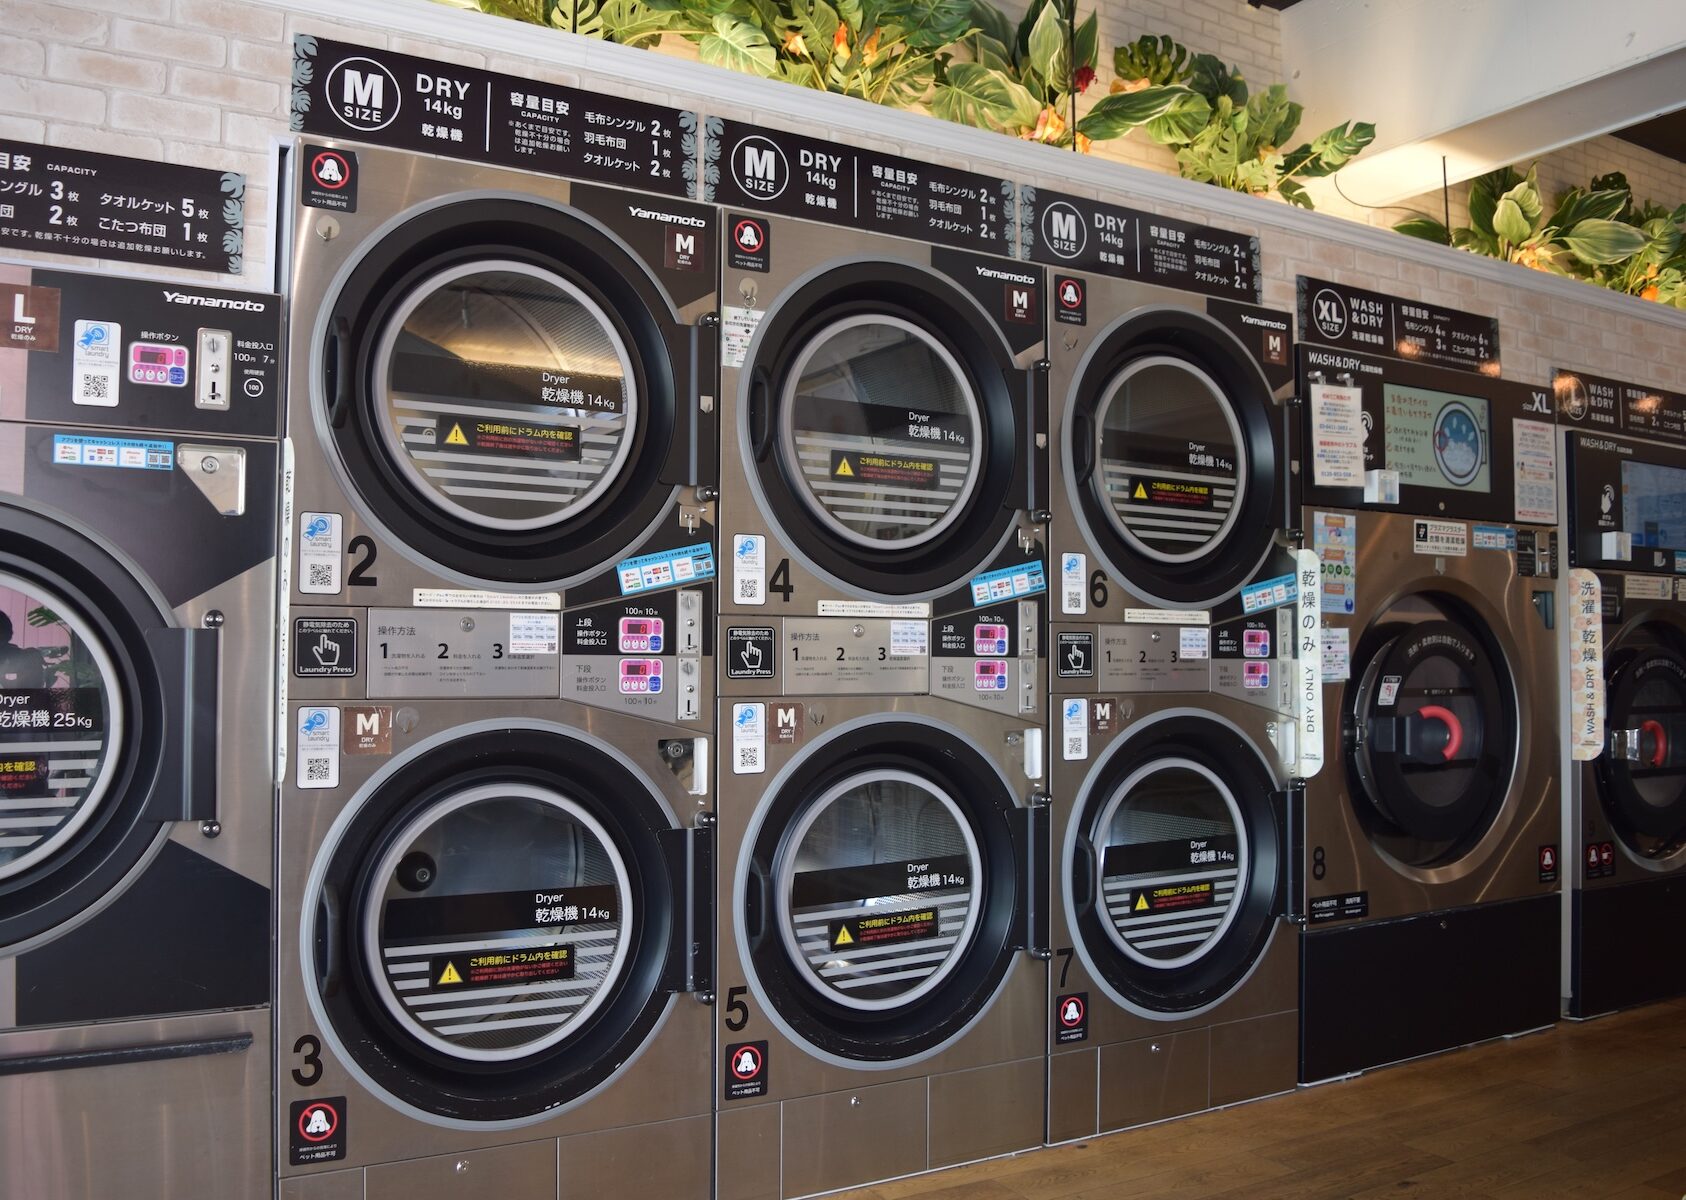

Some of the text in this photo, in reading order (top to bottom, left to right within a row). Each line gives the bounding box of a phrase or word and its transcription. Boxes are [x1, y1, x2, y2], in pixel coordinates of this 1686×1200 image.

[343, 69, 383, 109] M
[416, 73, 470, 100] DRY
[424, 98, 463, 120] 14kg
[510, 92, 570, 116] 容量目安
[344, 106, 381, 122] SIZE
[521, 111, 560, 123] CAPACITY
[584, 111, 646, 133] 毛布シングル
[421, 123, 463, 142] 乾燥機
[584, 131, 627, 150] 羽毛布団
[47, 163, 97, 176] CAPACITY
[583, 153, 640, 172] タオルケット
[744, 146, 775, 181] M
[800, 149, 841, 173] DRY
[807, 171, 836, 190] 14kg
[872, 165, 918, 186] 容量目安
[745, 179, 775, 193] SIZE
[881, 182, 911, 192] CAPACITY
[929, 182, 976, 200] 毛布シングル
[100, 193, 175, 214] タオルケット
[805, 192, 837, 210] 乾燥機
[929, 200, 962, 215] 羽毛布団
[629, 206, 705, 228] Yamamoto
[929, 217, 973, 234] タオルケット
[1052, 211, 1076, 241] M
[1094, 213, 1127, 233] DRY
[99, 217, 166, 238] こたつ布団
[1150, 226, 1185, 243] 容量目安
[676, 232, 695, 255] M
[1054, 240, 1076, 252] SIZE
[1100, 232, 1123, 248] 14kg
[976, 266, 1035, 284] Yamamoto
[1195, 271, 1229, 285] タオルケット
[14, 293, 36, 323] L
[163, 291, 265, 312] Yamamoto
[1013, 290, 1028, 309] M
[1350, 297, 1384, 315] WASH
[1318, 299, 1343, 324] XL
[1352, 312, 1384, 328] &DRY
[1241, 314, 1286, 330] Yamamoto
[1322, 322, 1340, 333] SIZE
[141, 330, 179, 342] 操作ボタン
[1269, 335, 1280, 352] M
[237, 340, 273, 351] 料金投入口
[1308, 351, 1361, 371] WASH&DRY
[542, 373, 570, 384] Dryer
[542, 387, 615, 410] 乾燥機 14Kg
[1589, 384, 1613, 397] WASH
[1532, 392, 1551, 414] XL
[1591, 396, 1613, 409] &DRY
[909, 412, 929, 422] Dryer
[476, 423, 573, 441] ご利用前にドラム内を確認
[908, 424, 964, 444] 乾燥機 14Kg
[1189, 442, 1205, 452] Dryer
[1580, 437, 1616, 452] WASH&DRY
[1216, 459, 1232, 470] 14Kg
[347, 535, 377, 586] 2
[769, 558, 793, 602] 4
[1090, 569, 1108, 608] 6
[1302, 569, 1316, 652] 乾燥のみ
[303, 621, 350, 629] 静電気除去のため
[378, 625, 416, 636] 操作方法
[576, 618, 592, 627] 上段
[942, 625, 954, 633] 上段
[791, 633, 820, 641] 操作方法
[380, 642, 503, 659] 1 2 3
[792, 647, 886, 661] 1 2 3
[1106, 651, 1177, 663] 1 2 3
[576, 665, 592, 673] 下段
[1306, 667, 1315, 733] DRY ONLY
[1586, 667, 1595, 734] WASH & DRY
[53, 712, 92, 729] 25Kg
[778, 708, 795, 727] M
[1096, 703, 1110, 720] M
[356, 713, 379, 735] M
[1190, 841, 1207, 849] Dryer
[1217, 851, 1234, 861] 14Kg
[1312, 846, 1326, 880] 8
[907, 863, 929, 873] Dryer
[907, 874, 964, 889] 乾燥機 14Kg
[536, 893, 563, 904] Dryer
[535, 906, 610, 923] 乾燥機 14Kg
[470, 949, 568, 967] ご利用前にドラム内を確認
[1057, 948, 1073, 987] 7
[725, 986, 748, 1031] 5
[292, 1034, 323, 1086] 3
